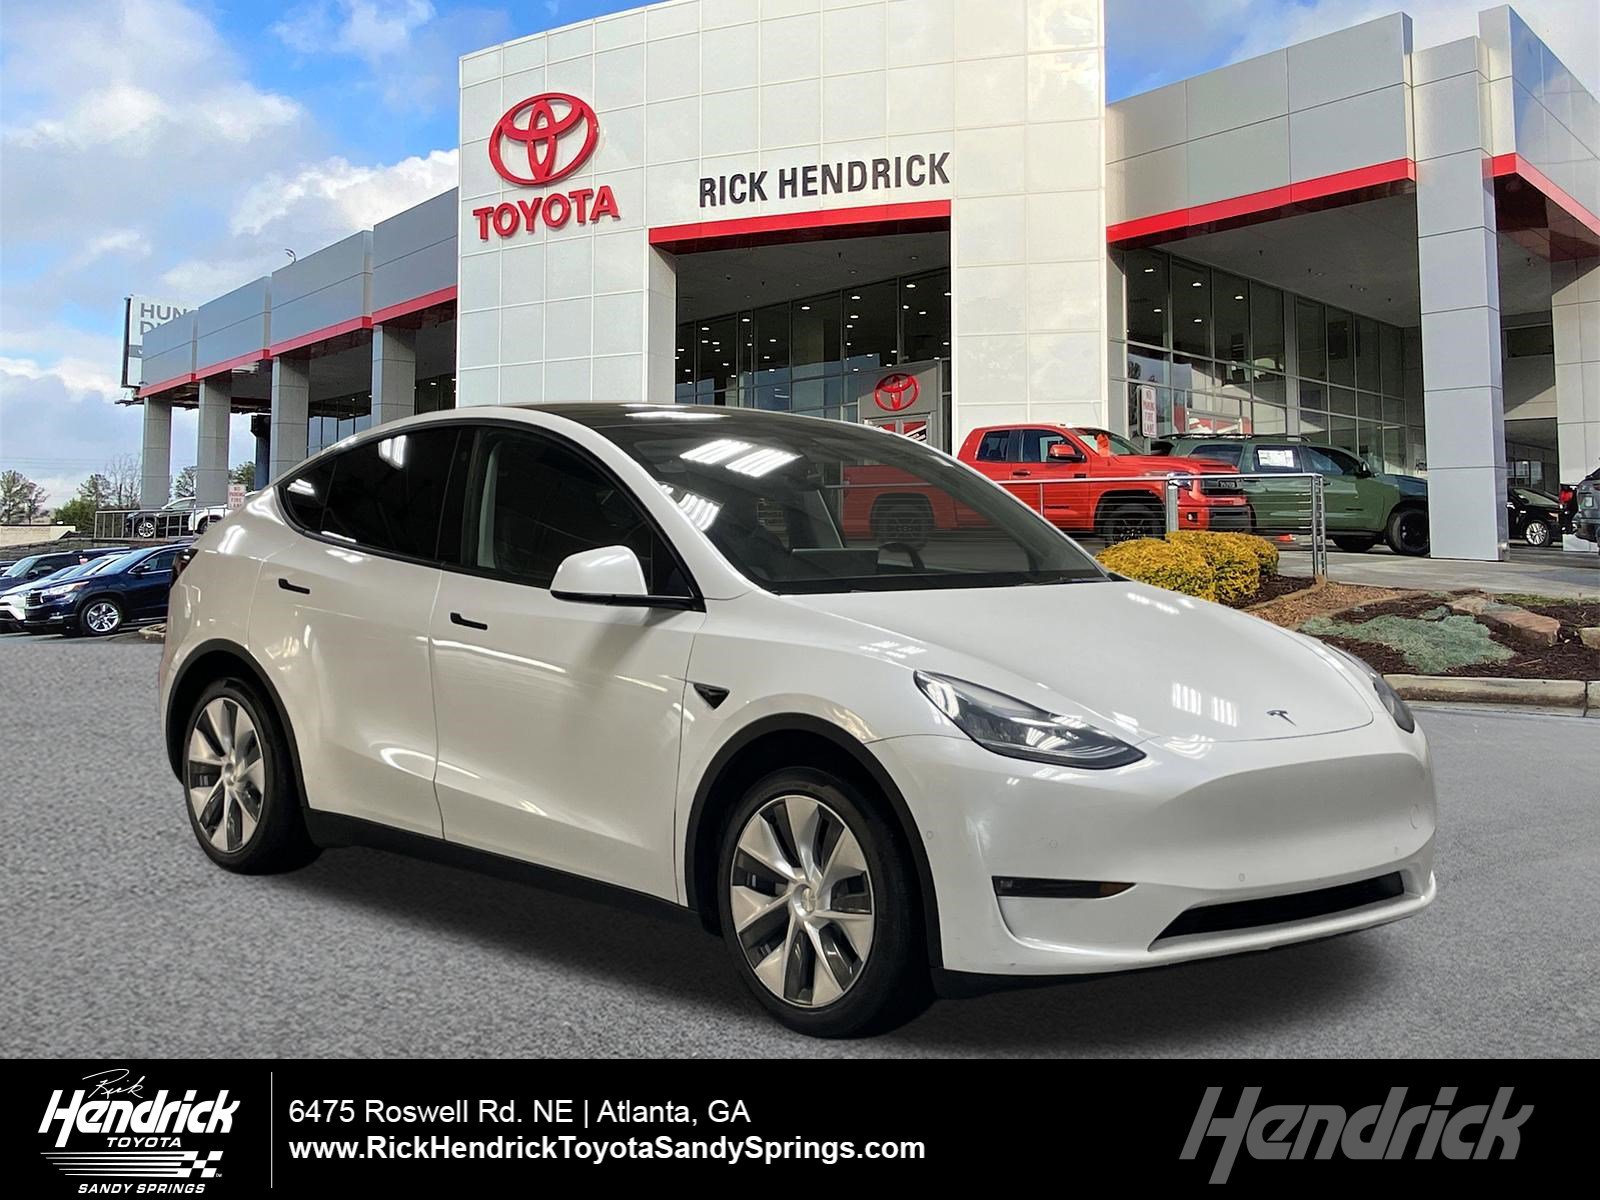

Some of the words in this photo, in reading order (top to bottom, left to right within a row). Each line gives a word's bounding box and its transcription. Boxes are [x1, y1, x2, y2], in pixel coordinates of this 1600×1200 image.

[699, 170, 769, 208] RICK
[778, 152, 951, 199] HENDRICK
[472, 185, 621, 241] TOYOTA
